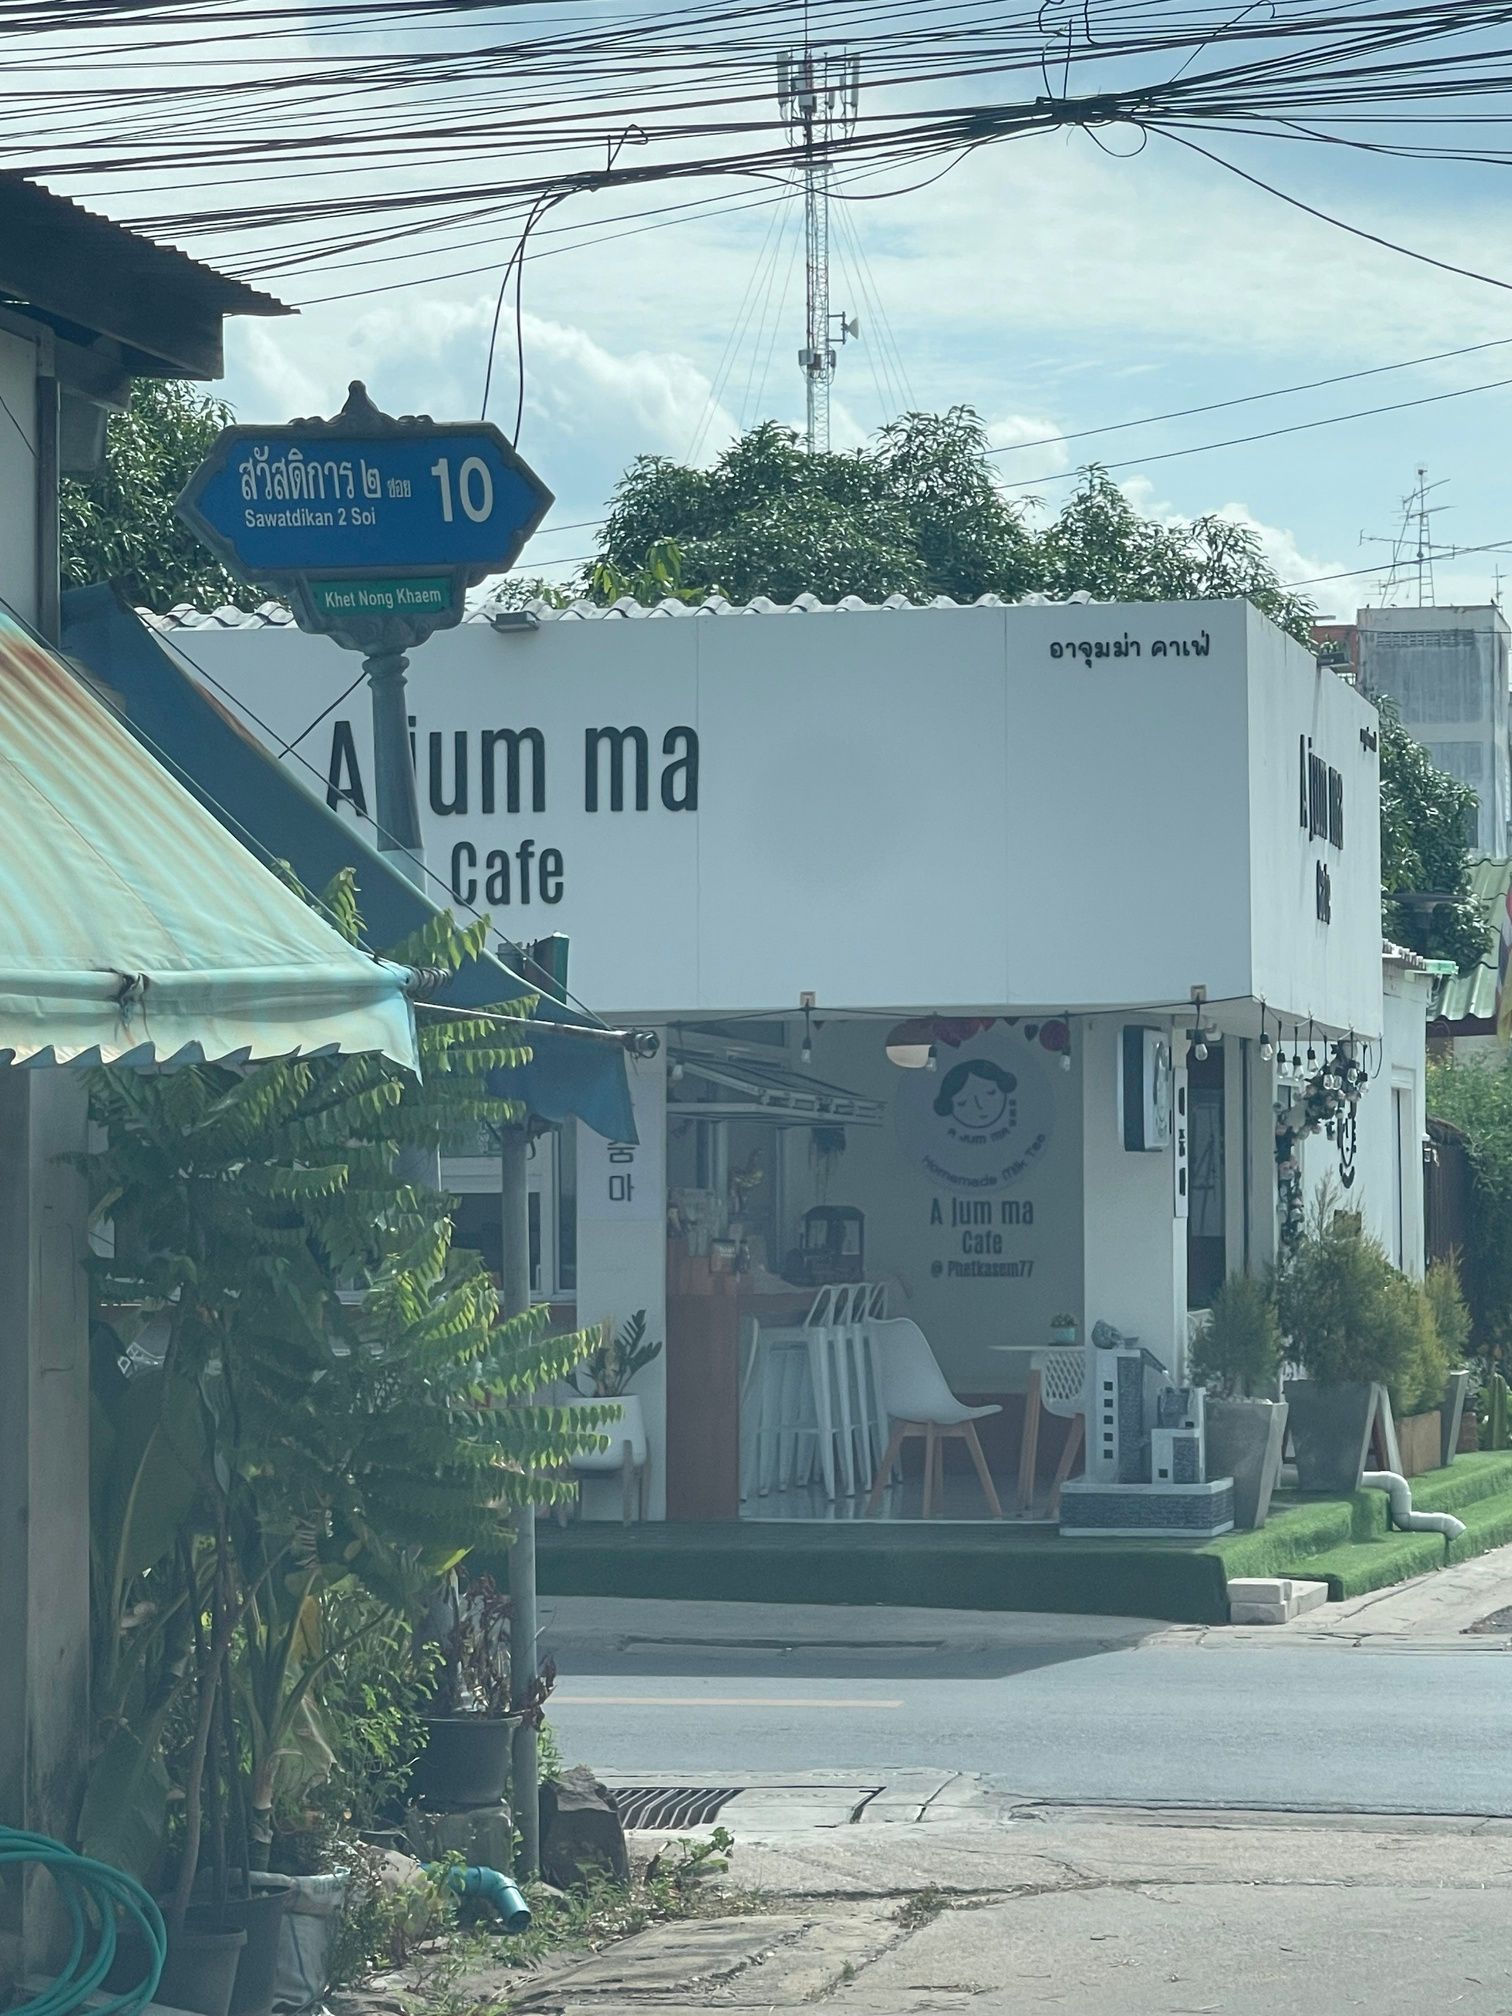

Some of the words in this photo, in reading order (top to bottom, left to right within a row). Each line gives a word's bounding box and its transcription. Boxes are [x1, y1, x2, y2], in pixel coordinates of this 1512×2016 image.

[239, 445, 355, 500] สวัสดิการ
[360, 459, 382, 498] ๒
[431, 456, 494, 524] 10
[245, 509, 333, 528] Sawatdikan
[338, 508, 347, 525] 2
[351, 507, 376, 525] Soi
[325, 592, 355, 608] Khet
[359, 590, 394, 609] Nong
[396, 588, 442, 605] Khaem
[1050, 632, 1141, 669] อาจุมม่า
[1151, 630, 1210, 657] คาเฟ่
[326, 720, 368, 817] A
[584, 725, 700, 813] ma
[451, 839, 564, 906] Cafe
[930, 1198, 943, 1225] A
[1001, 1200, 1034, 1225] ma
[962, 1230, 1003, 1254] Cafe
